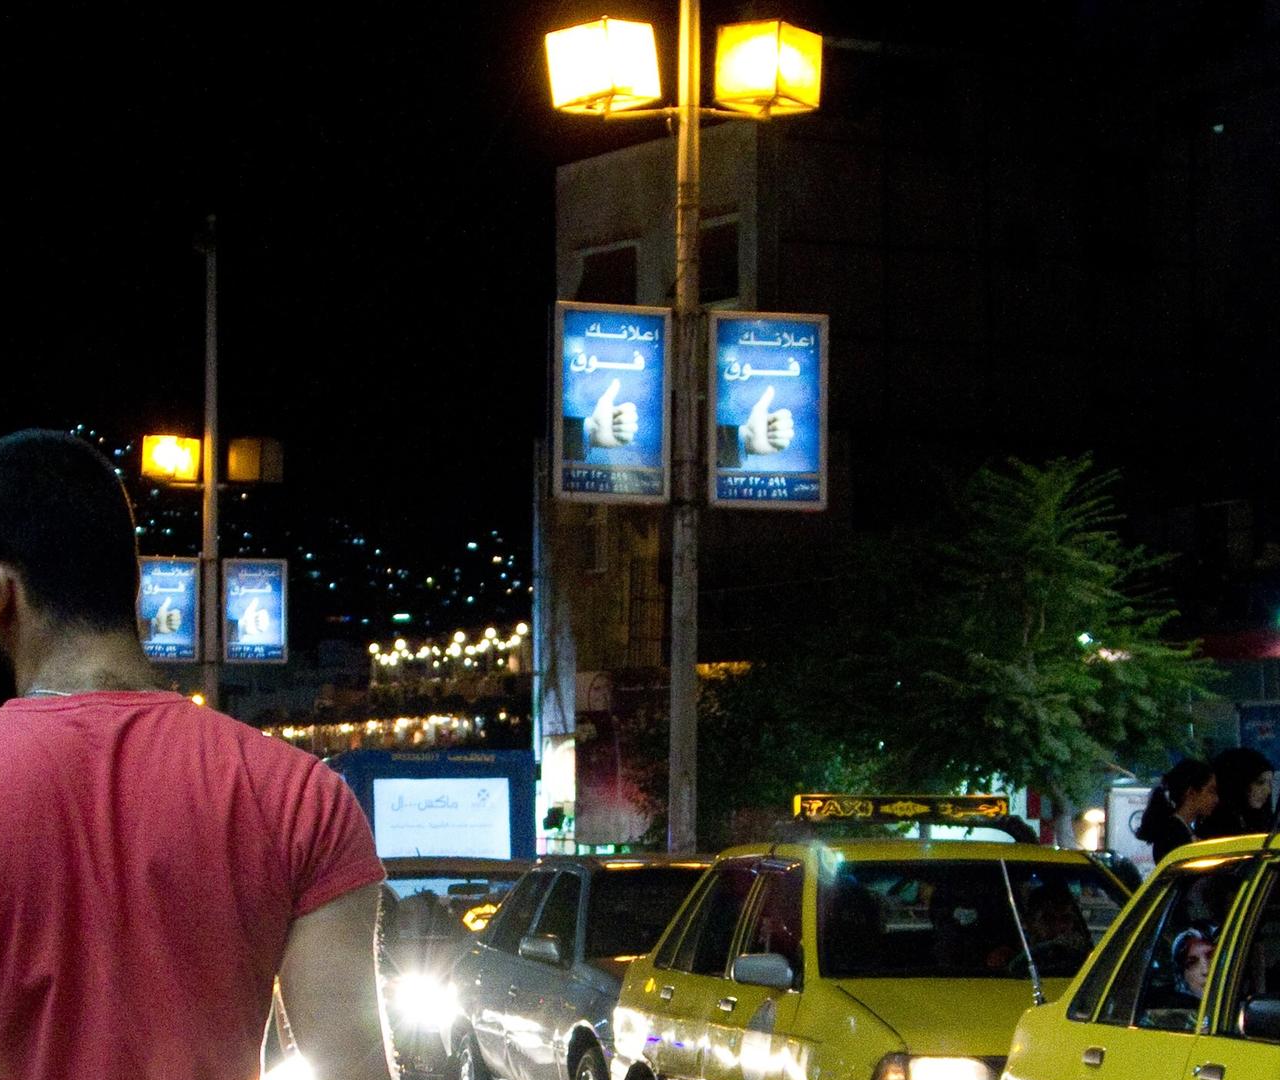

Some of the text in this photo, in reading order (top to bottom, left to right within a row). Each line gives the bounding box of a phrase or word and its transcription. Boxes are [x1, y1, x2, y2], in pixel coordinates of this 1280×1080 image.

[570, 348, 645, 373] فوق
[724, 355, 801, 382] فوق
[801, 799, 874, 817] TAXI
